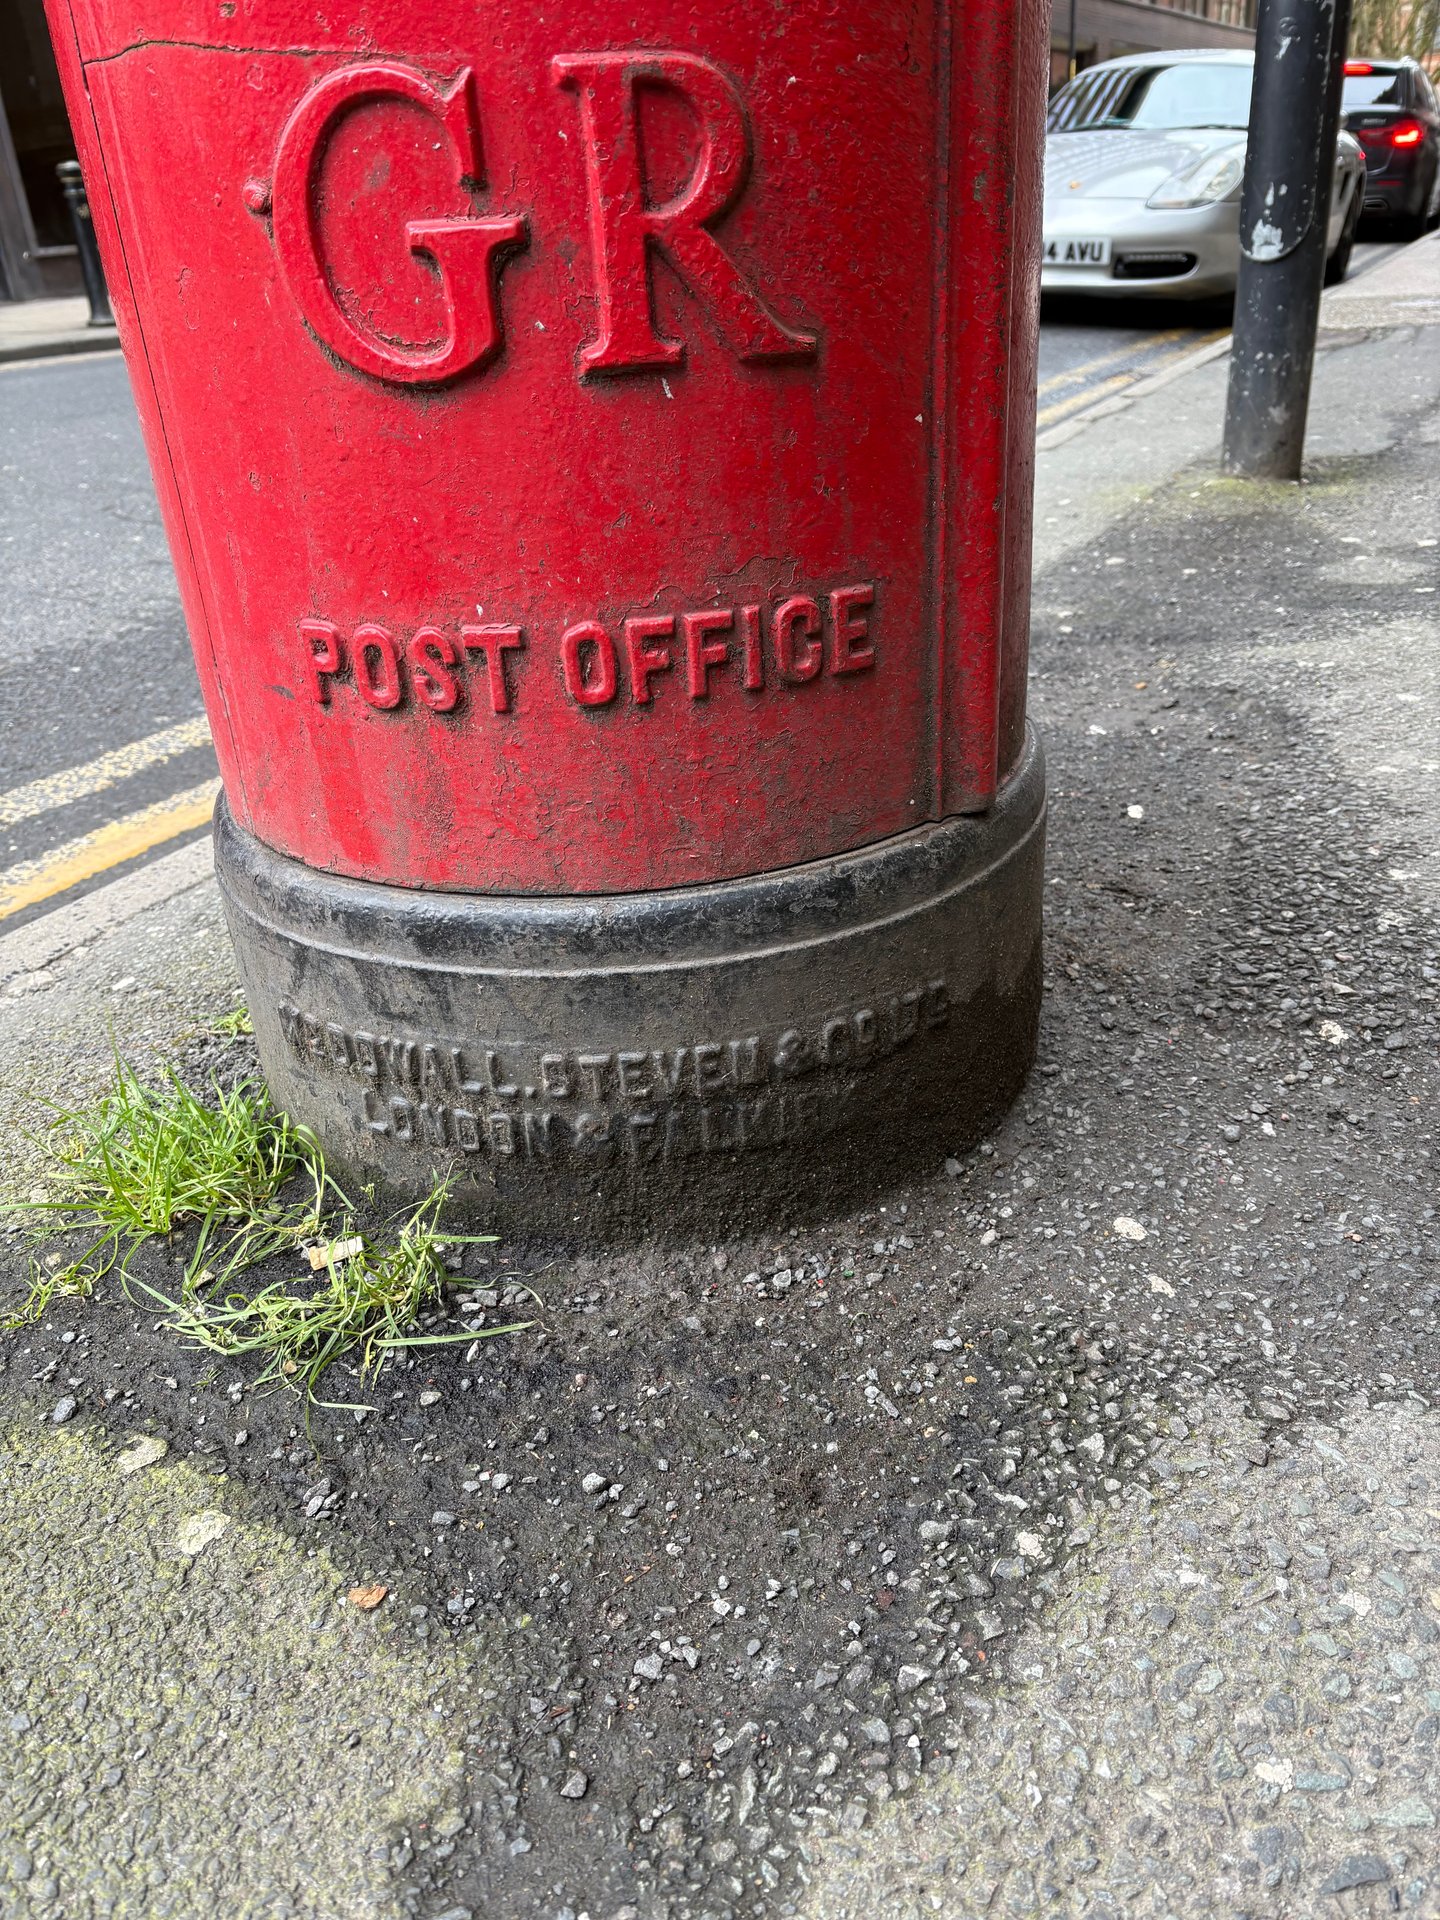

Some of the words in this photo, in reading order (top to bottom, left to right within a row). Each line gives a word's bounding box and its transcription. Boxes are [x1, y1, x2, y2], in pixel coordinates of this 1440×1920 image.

[272, 50, 818, 387] GR
[1065, 241, 1103, 262] AVU
[300, 615, 524, 715] POST
[560, 582, 878, 706] OFFICE
[541, 1036, 759, 1100] STEVEN
[361, 1088, 552, 1157] LONDON
